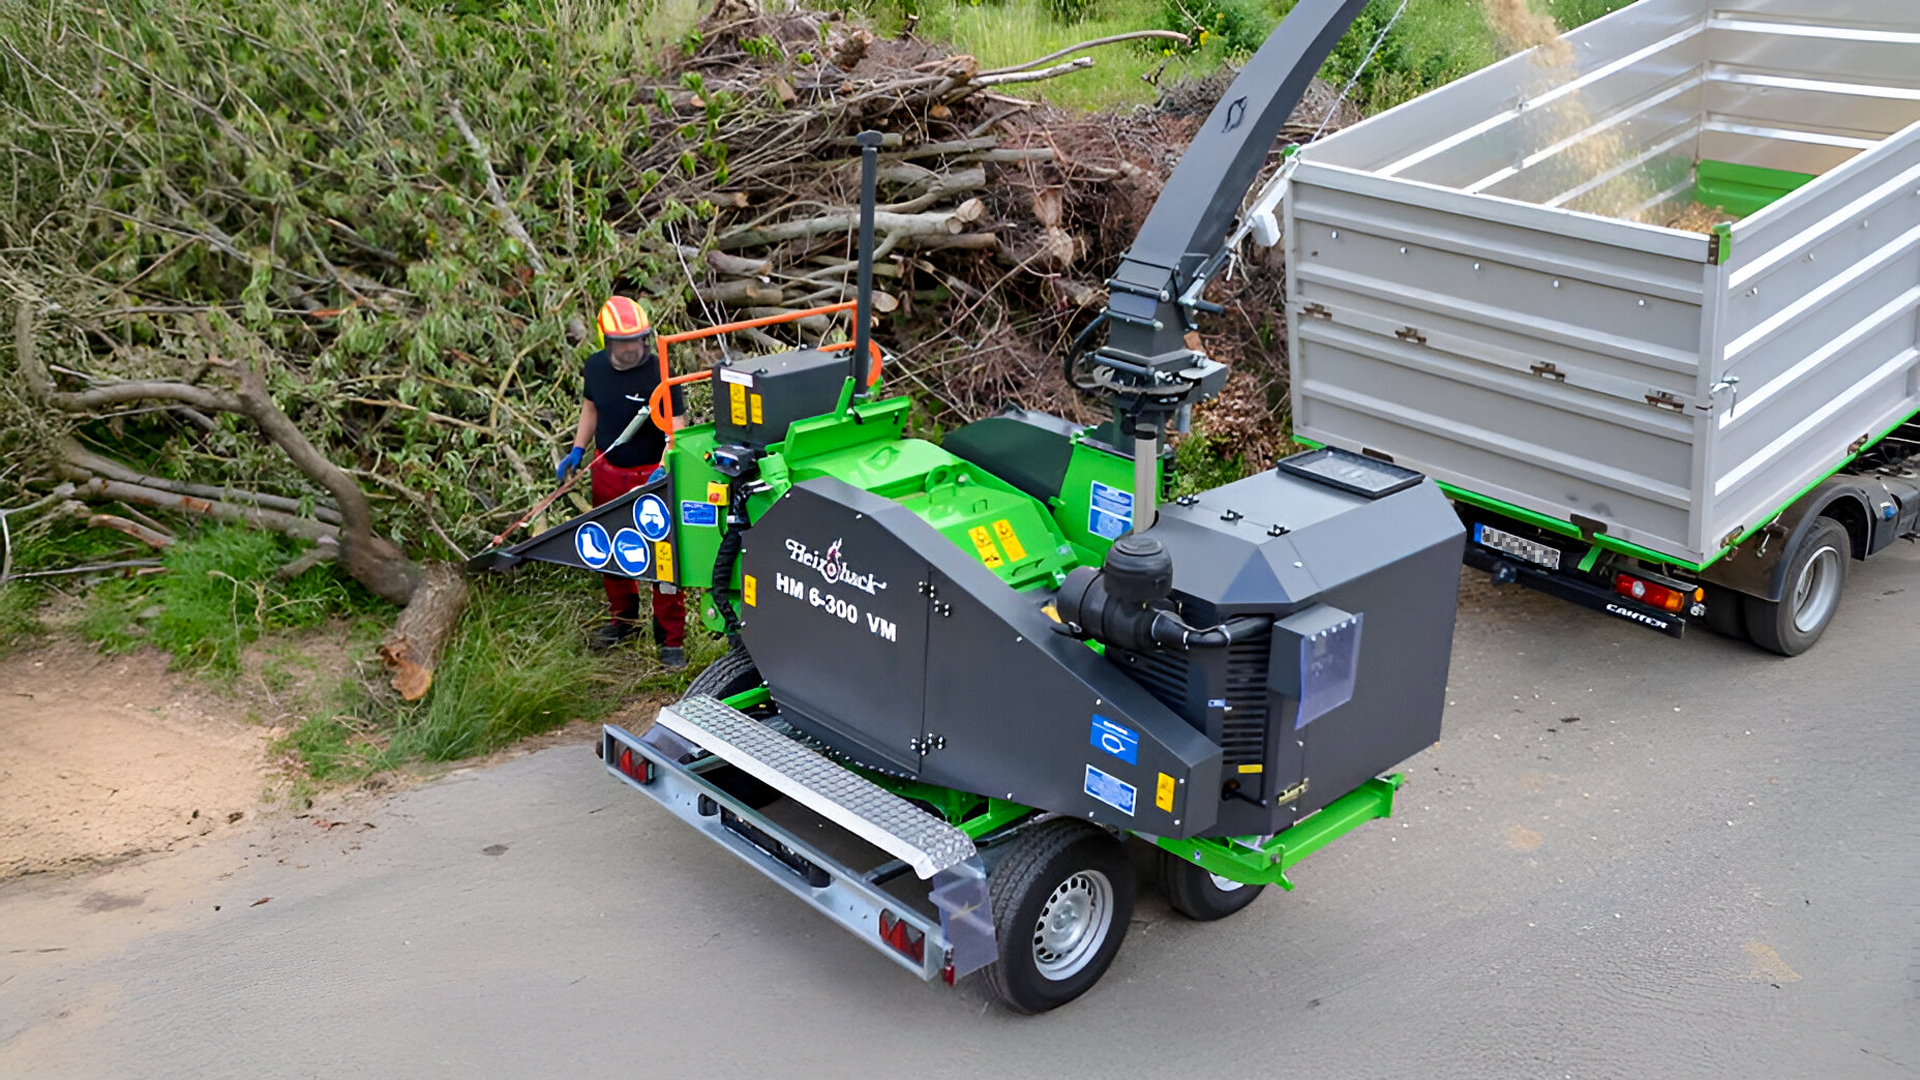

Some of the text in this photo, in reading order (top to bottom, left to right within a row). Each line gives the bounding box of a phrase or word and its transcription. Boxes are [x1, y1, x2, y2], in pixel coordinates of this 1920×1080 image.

[776, 572, 897, 643] HM 6-300 VM
